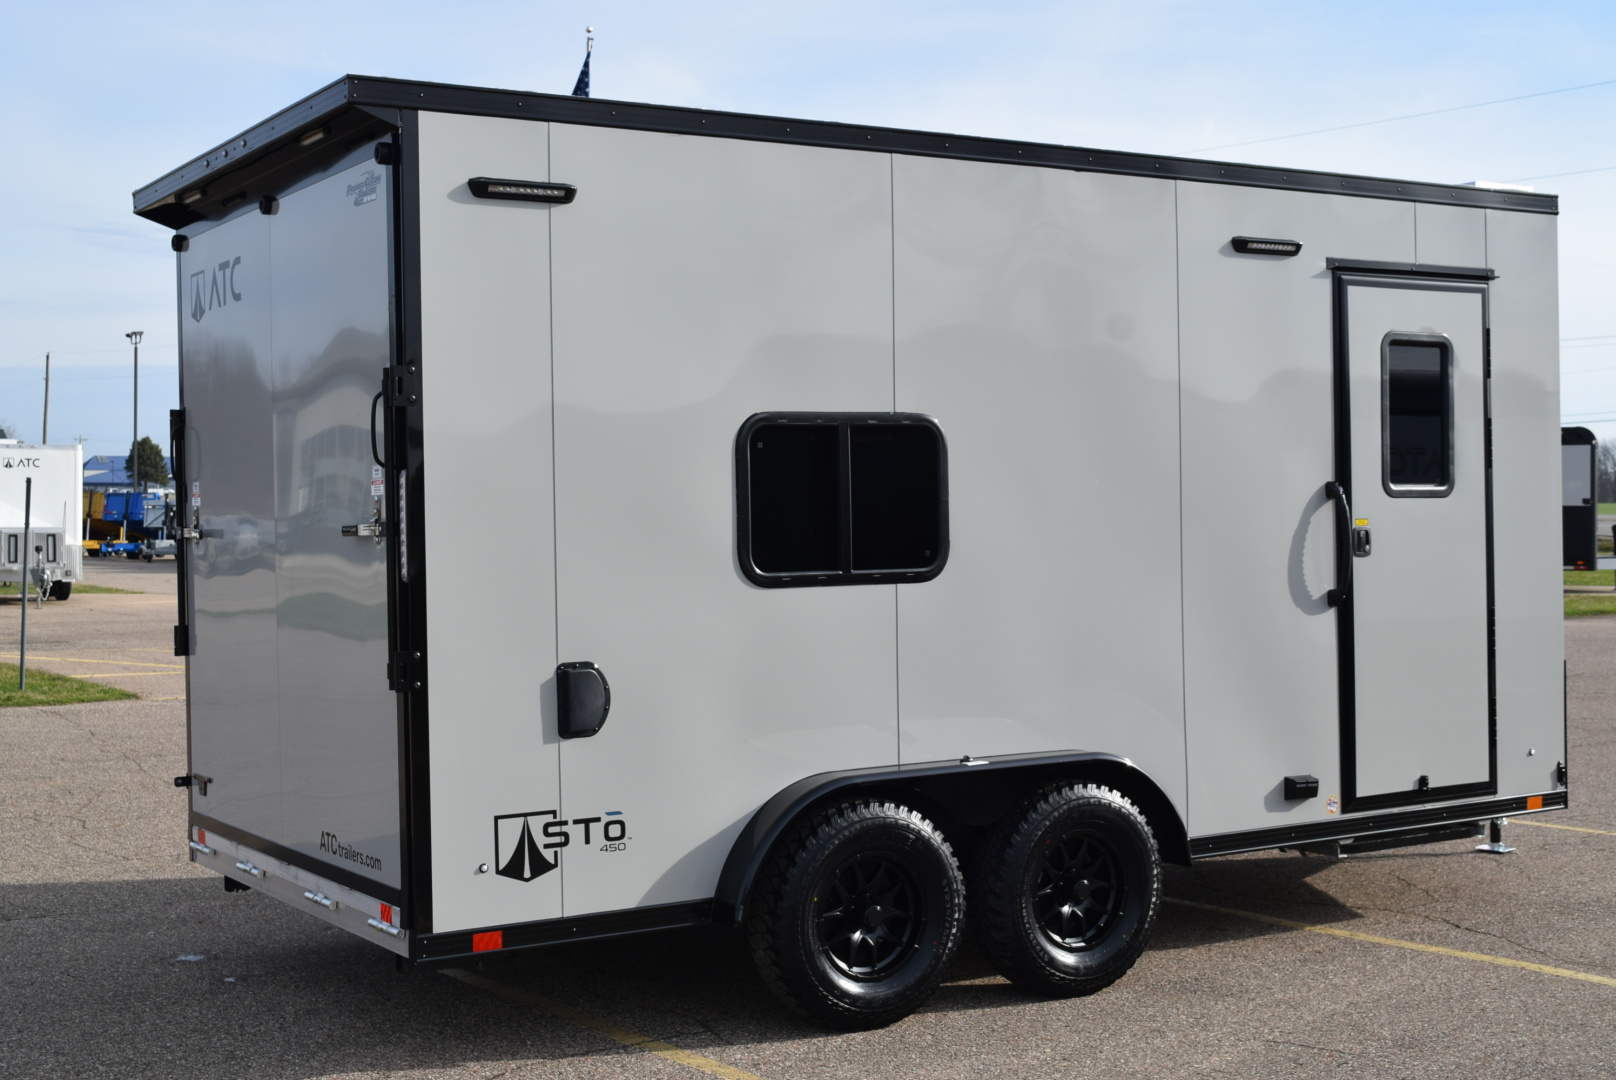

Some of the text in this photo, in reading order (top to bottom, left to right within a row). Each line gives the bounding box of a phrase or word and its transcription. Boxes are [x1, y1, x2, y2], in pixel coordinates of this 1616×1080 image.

[208, 255, 242, 311] ATC
[16, 457, 41, 468] ATC
[319, 830, 382, 872] ATCtrailers.com
[600, 842, 626, 853] 450
